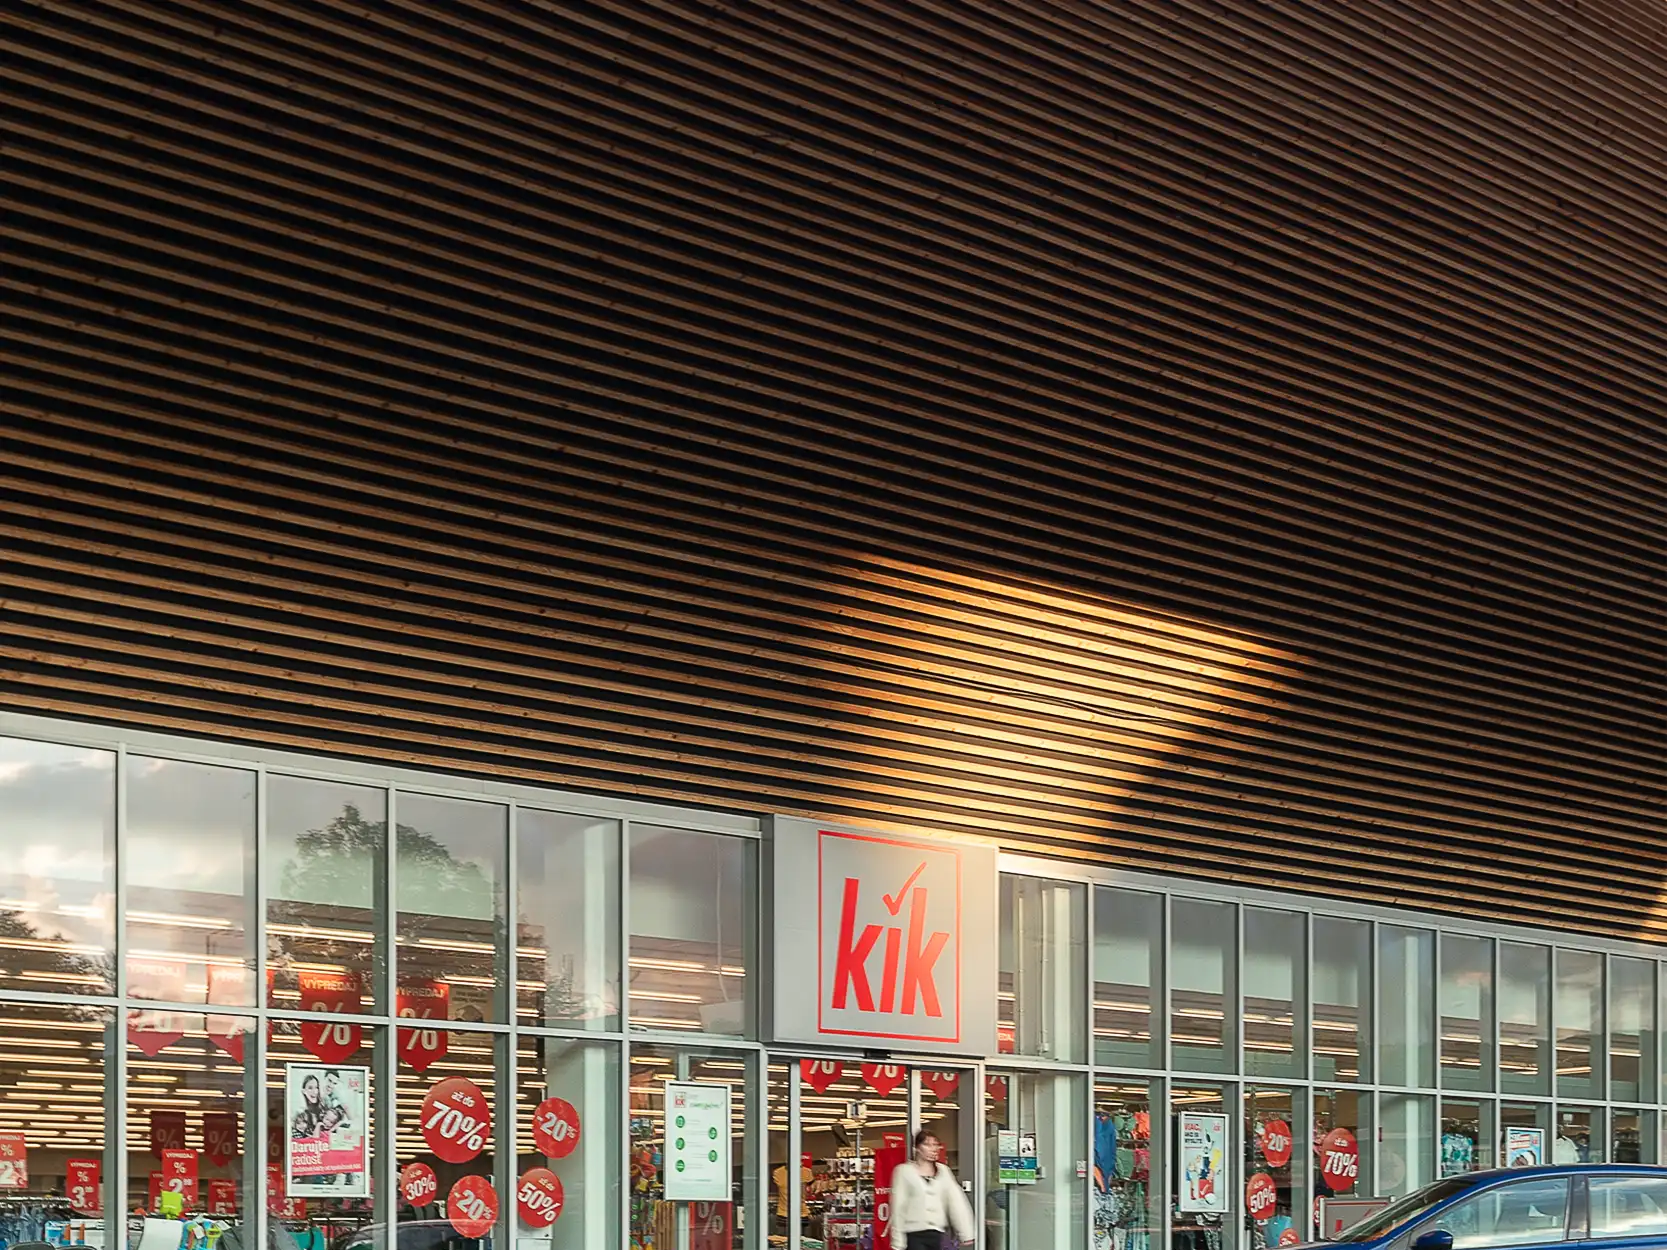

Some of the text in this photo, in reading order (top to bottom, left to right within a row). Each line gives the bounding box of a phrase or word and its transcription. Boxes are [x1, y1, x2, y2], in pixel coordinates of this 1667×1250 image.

[831, 862, 950, 1018] kik
[425, 1101, 486, 1151] 70%
[1324, 1150, 1358, 1177] 70%
[405, 1173, 437, 1201] 30%
[517, 1182, 561, 1222] 50%
[1249, 1185, 1276, 1213] 50%
